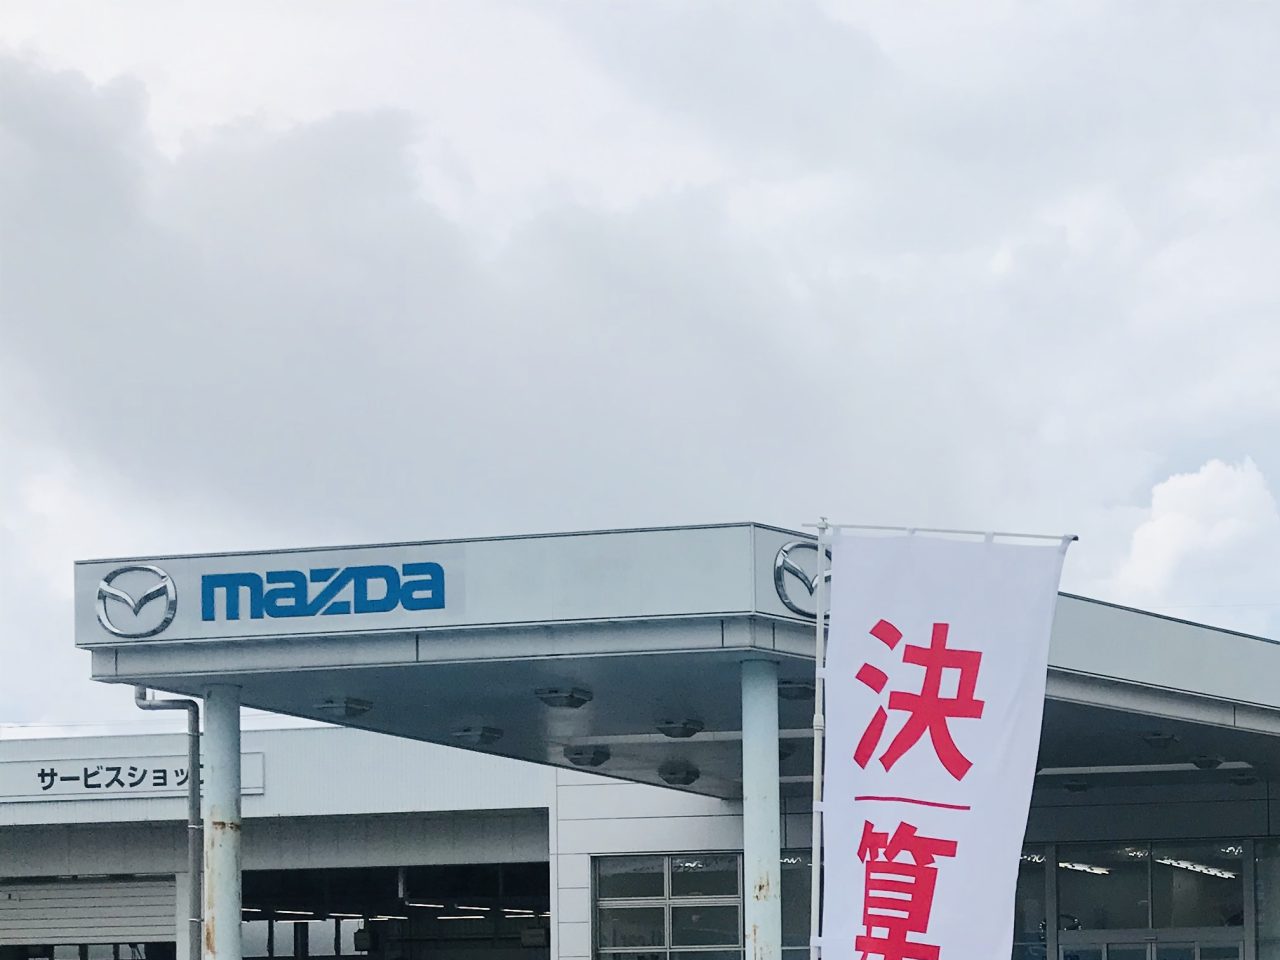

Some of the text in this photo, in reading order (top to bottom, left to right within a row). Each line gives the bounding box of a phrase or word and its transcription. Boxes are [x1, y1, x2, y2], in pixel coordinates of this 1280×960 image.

[201, 562, 446, 622] mazda
[37, 764, 204, 791] サービスショッ
